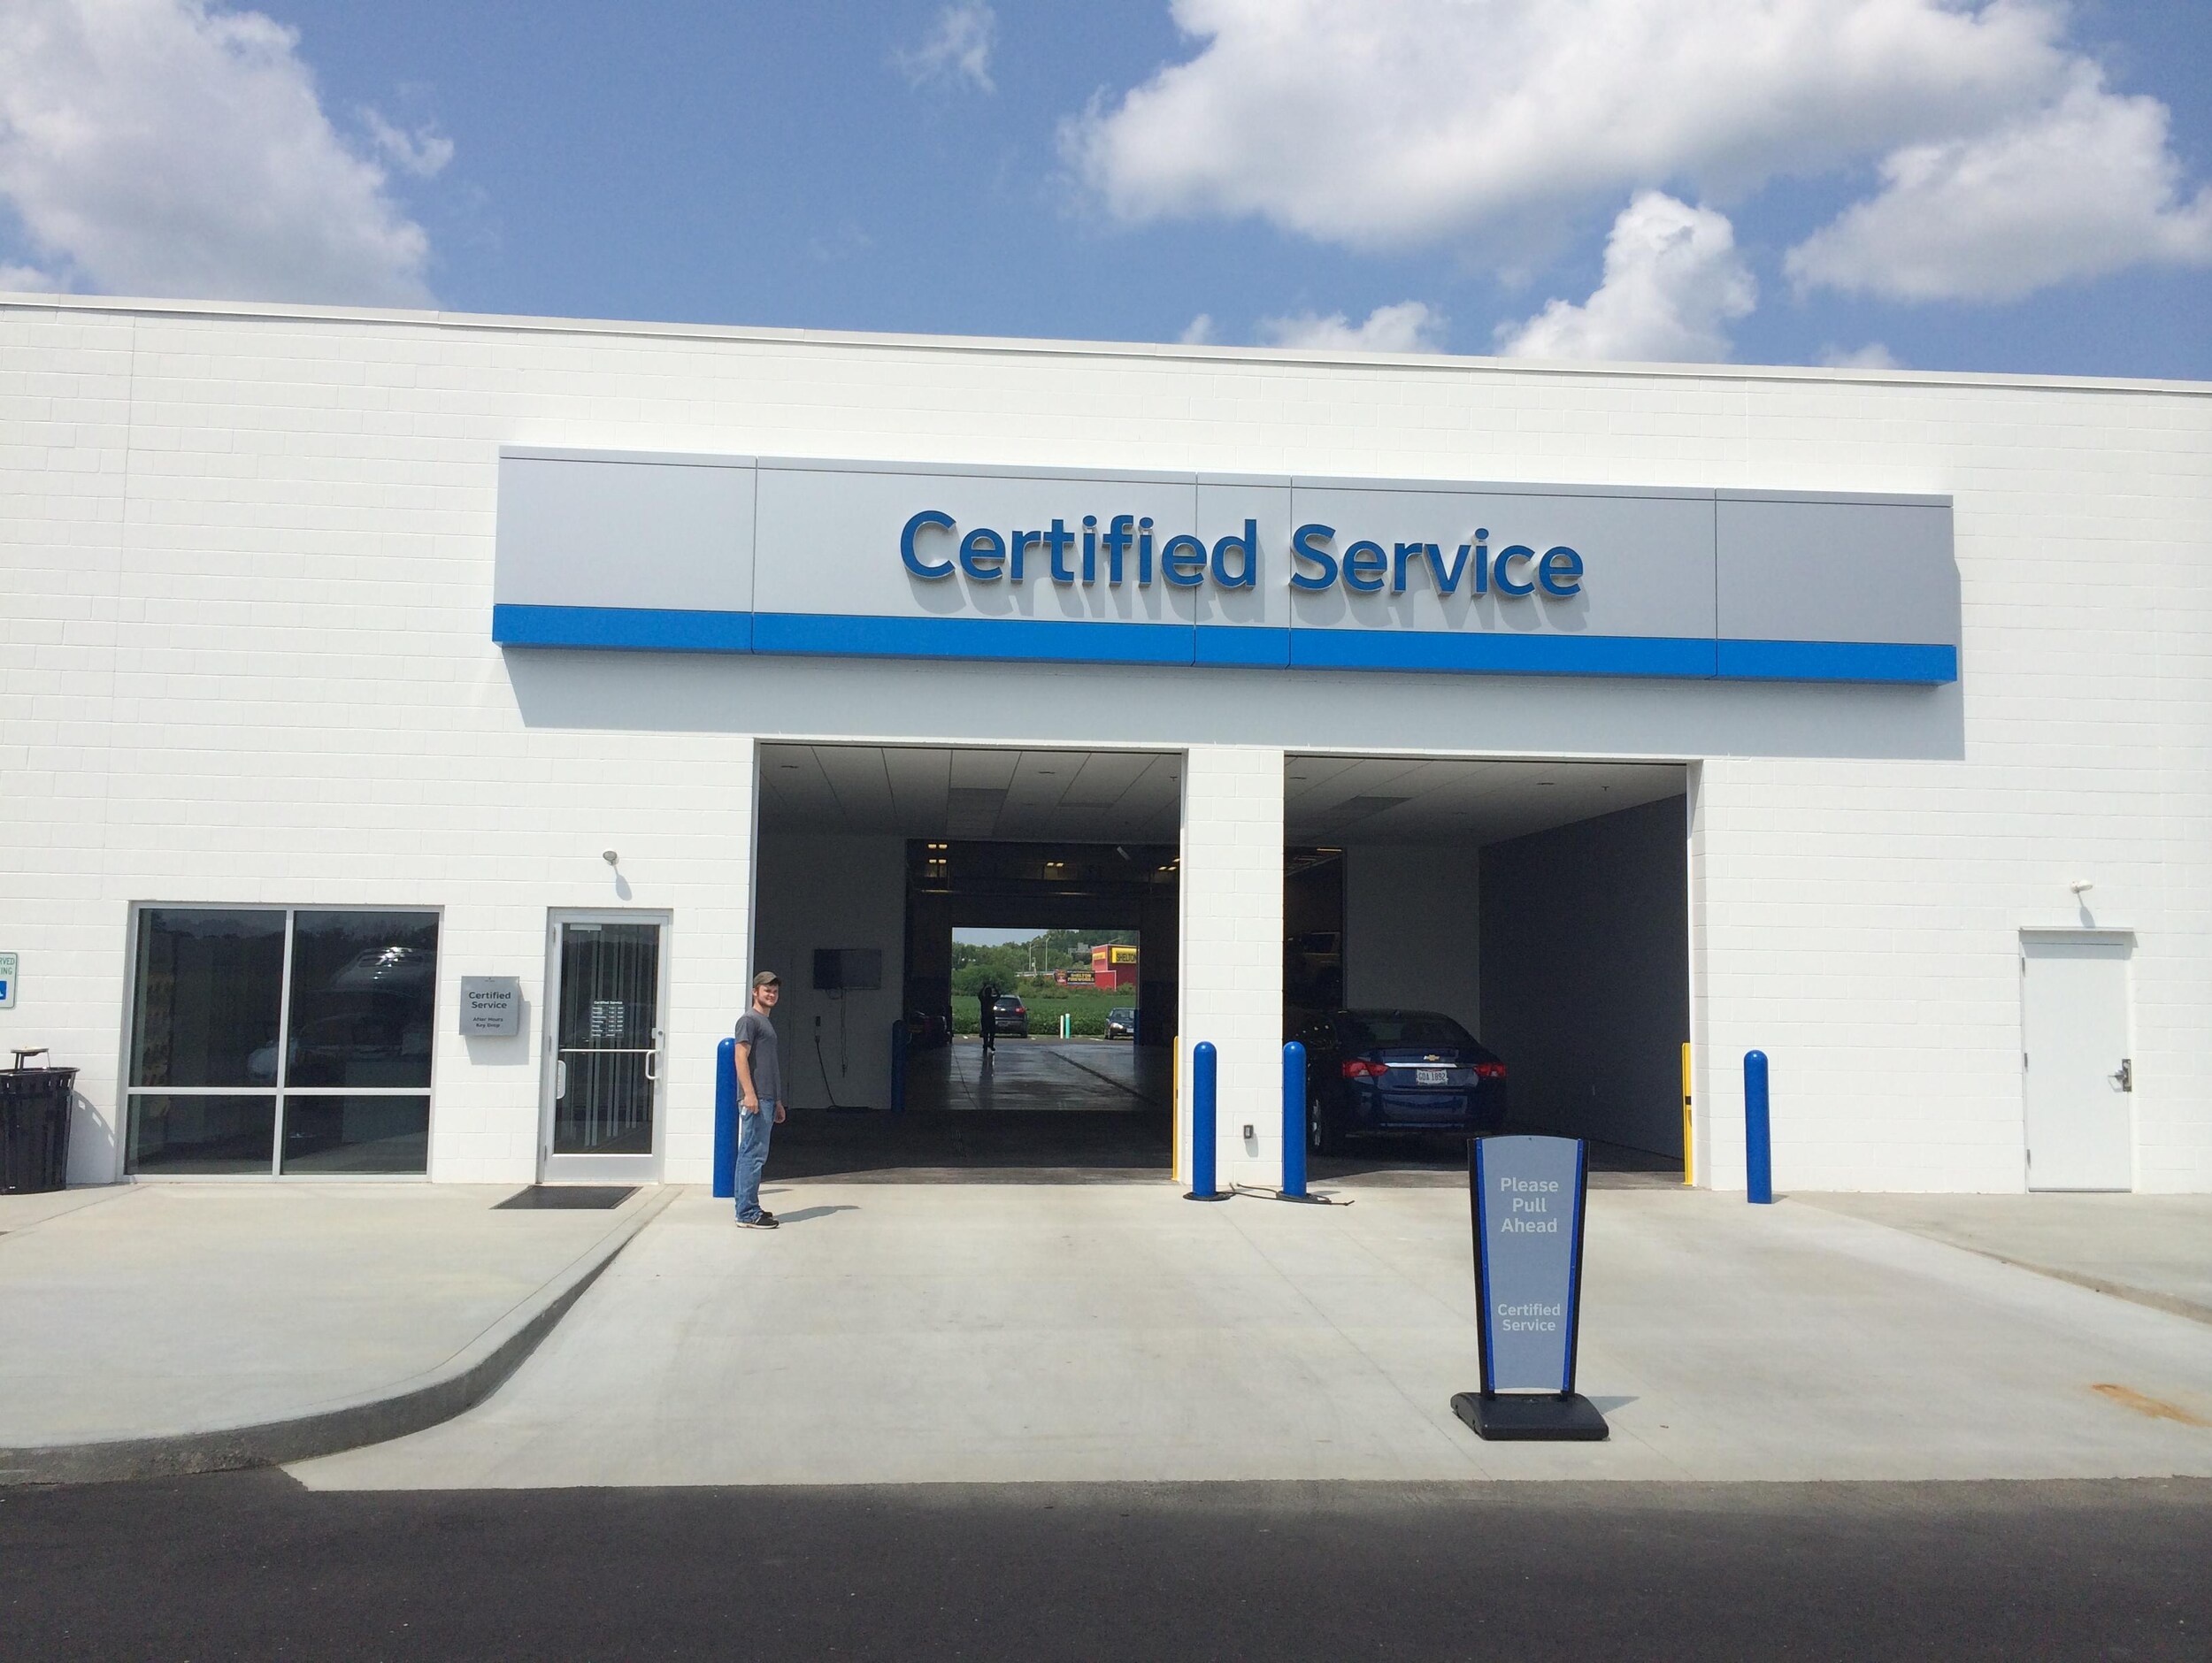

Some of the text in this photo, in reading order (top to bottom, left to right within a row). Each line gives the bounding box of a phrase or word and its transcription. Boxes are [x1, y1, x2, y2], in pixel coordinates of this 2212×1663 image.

[900, 510, 1584, 598] Certified Service
[468, 991, 511, 1000] Certified
[471, 1000, 508, 1009] Service
[1500, 1177, 1559, 1192] Please
[1512, 1198, 1547, 1213] Pull
[1501, 1218, 1558, 1233] Ahead
[1497, 1303, 1561, 1317] Certified
[1502, 1319, 1556, 1331] Service
